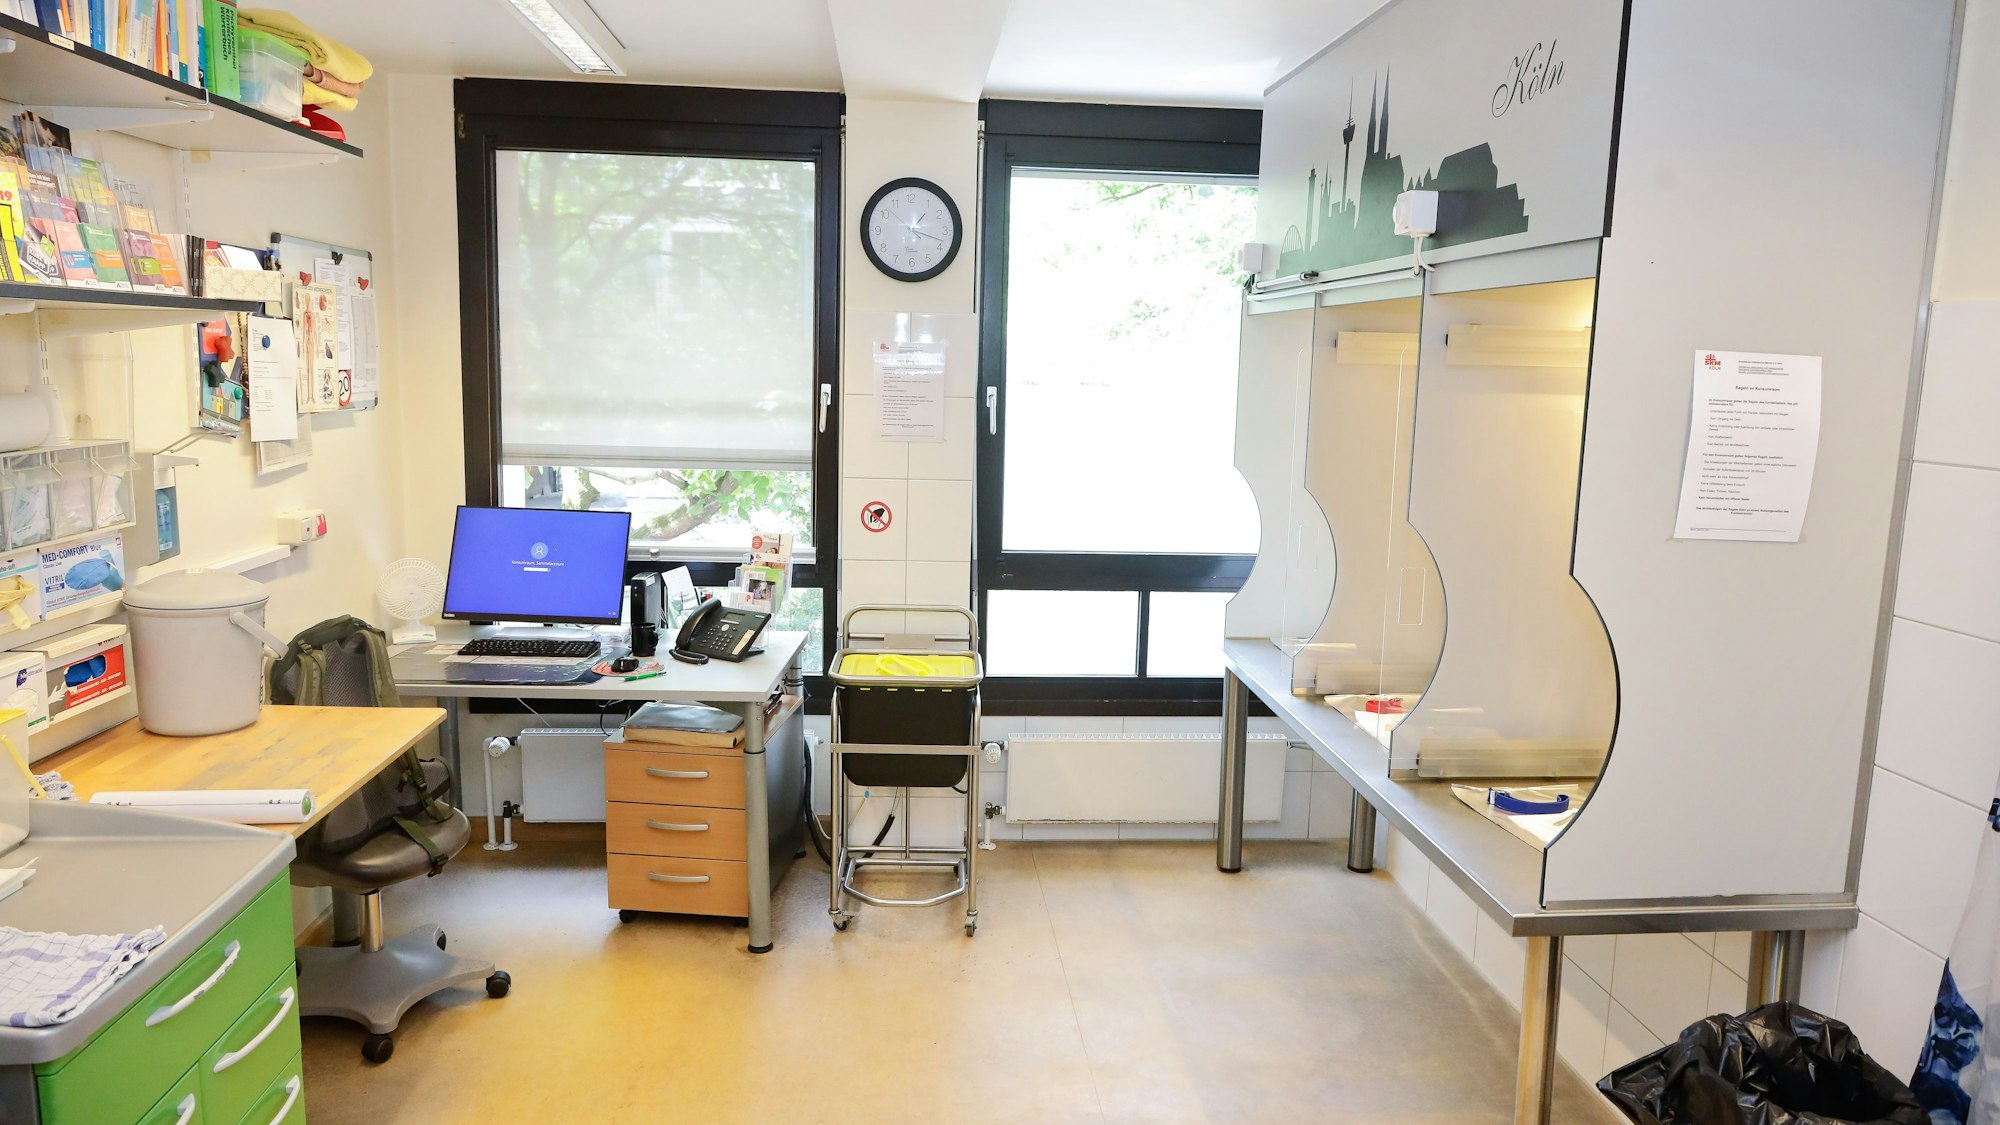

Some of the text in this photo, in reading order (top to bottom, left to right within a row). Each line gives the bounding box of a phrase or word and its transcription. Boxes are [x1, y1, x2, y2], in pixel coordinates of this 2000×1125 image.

[1491, 39, 1566, 118] Köln
[906, 193, 916, 204] 12
[891, 199, 899, 209] 11
[880, 209, 890, 219] 10
[936, 209, 943, 220] 2
[874, 225, 882, 236] 9
[942, 225, 949, 236] 3
[880, 243, 887, 253] 8
[936, 242, 943, 252] 4
[892, 254, 899, 263] 7
[908, 257, 915, 268] 6
[924, 254, 931, 264] 5
[338, 376, 350, 397] 20
[45, 575, 64, 585] VITRIL
